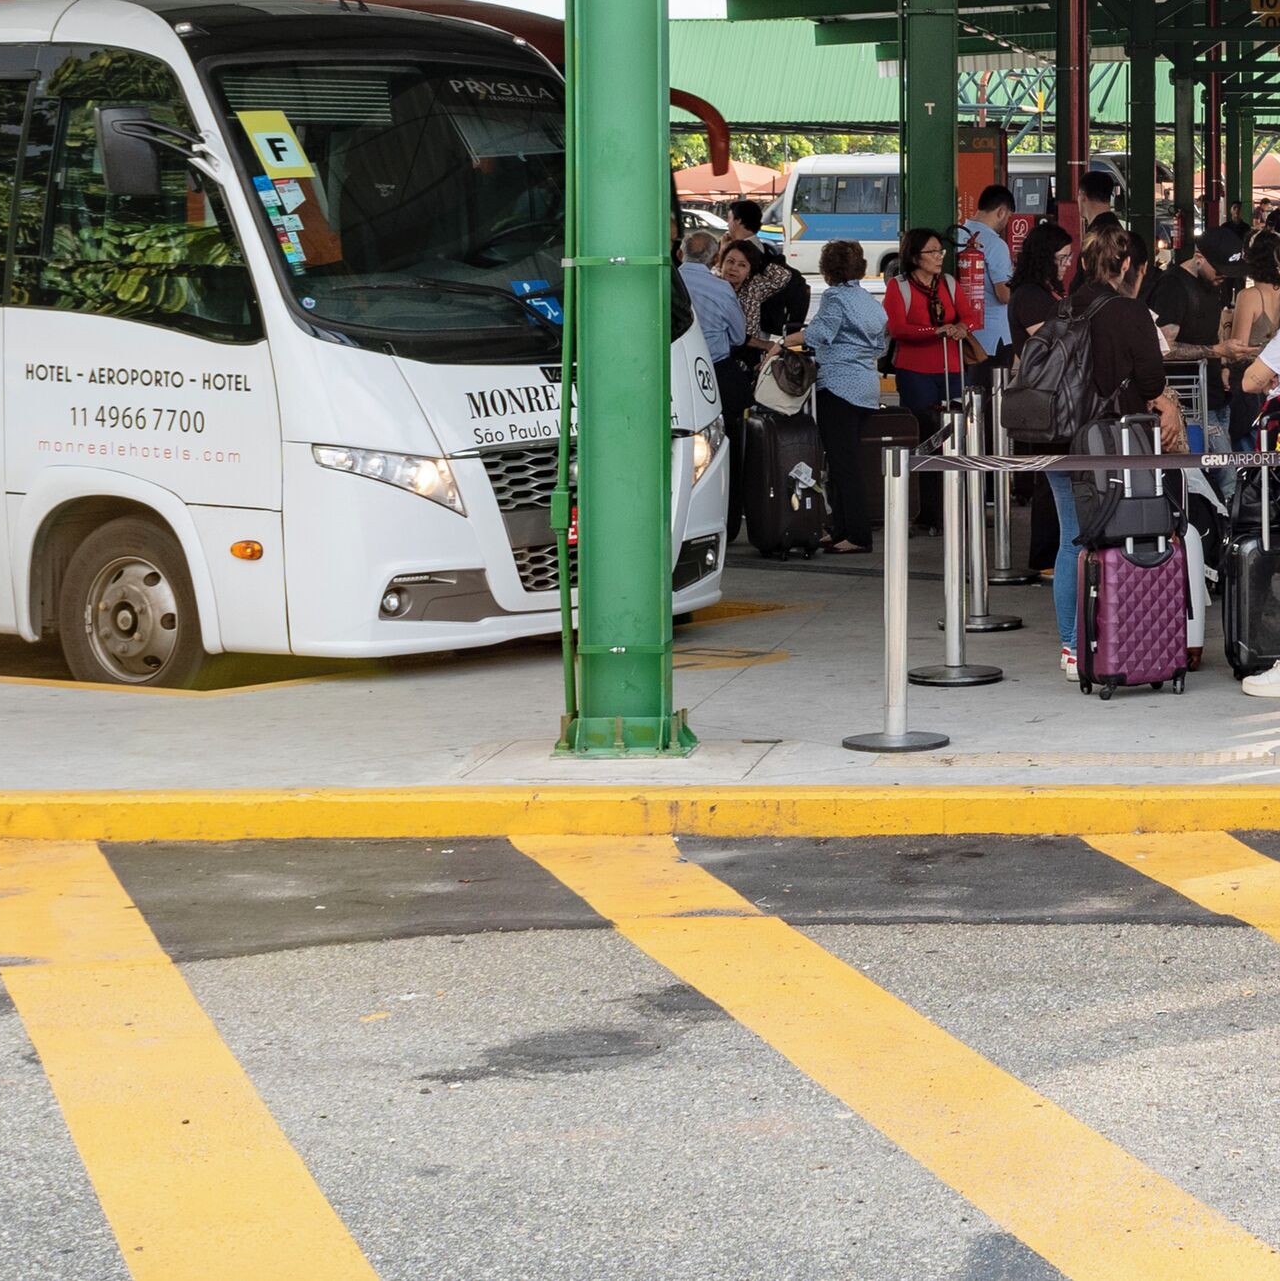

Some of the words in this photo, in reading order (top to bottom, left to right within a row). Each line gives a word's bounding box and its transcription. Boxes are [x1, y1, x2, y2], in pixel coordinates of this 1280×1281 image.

[448, 79, 555, 100] PRYSLLA
[265, 137, 289, 162] F
[25, 363, 72, 383] HOTEL
[88, 367, 184, 389] AEROPORTO
[202, 372, 252, 392] HOTEL
[698, 369, 714, 392] 28
[464, 381, 578, 420] MONRE
[70, 406, 88, 427] 11
[94, 405, 147, 430] 4966
[152, 407, 206, 434] 7700
[473, 426, 505, 445] São
[509, 420, 552, 441] Paulo
[37, 438, 242, 464] monrealehotels.com
